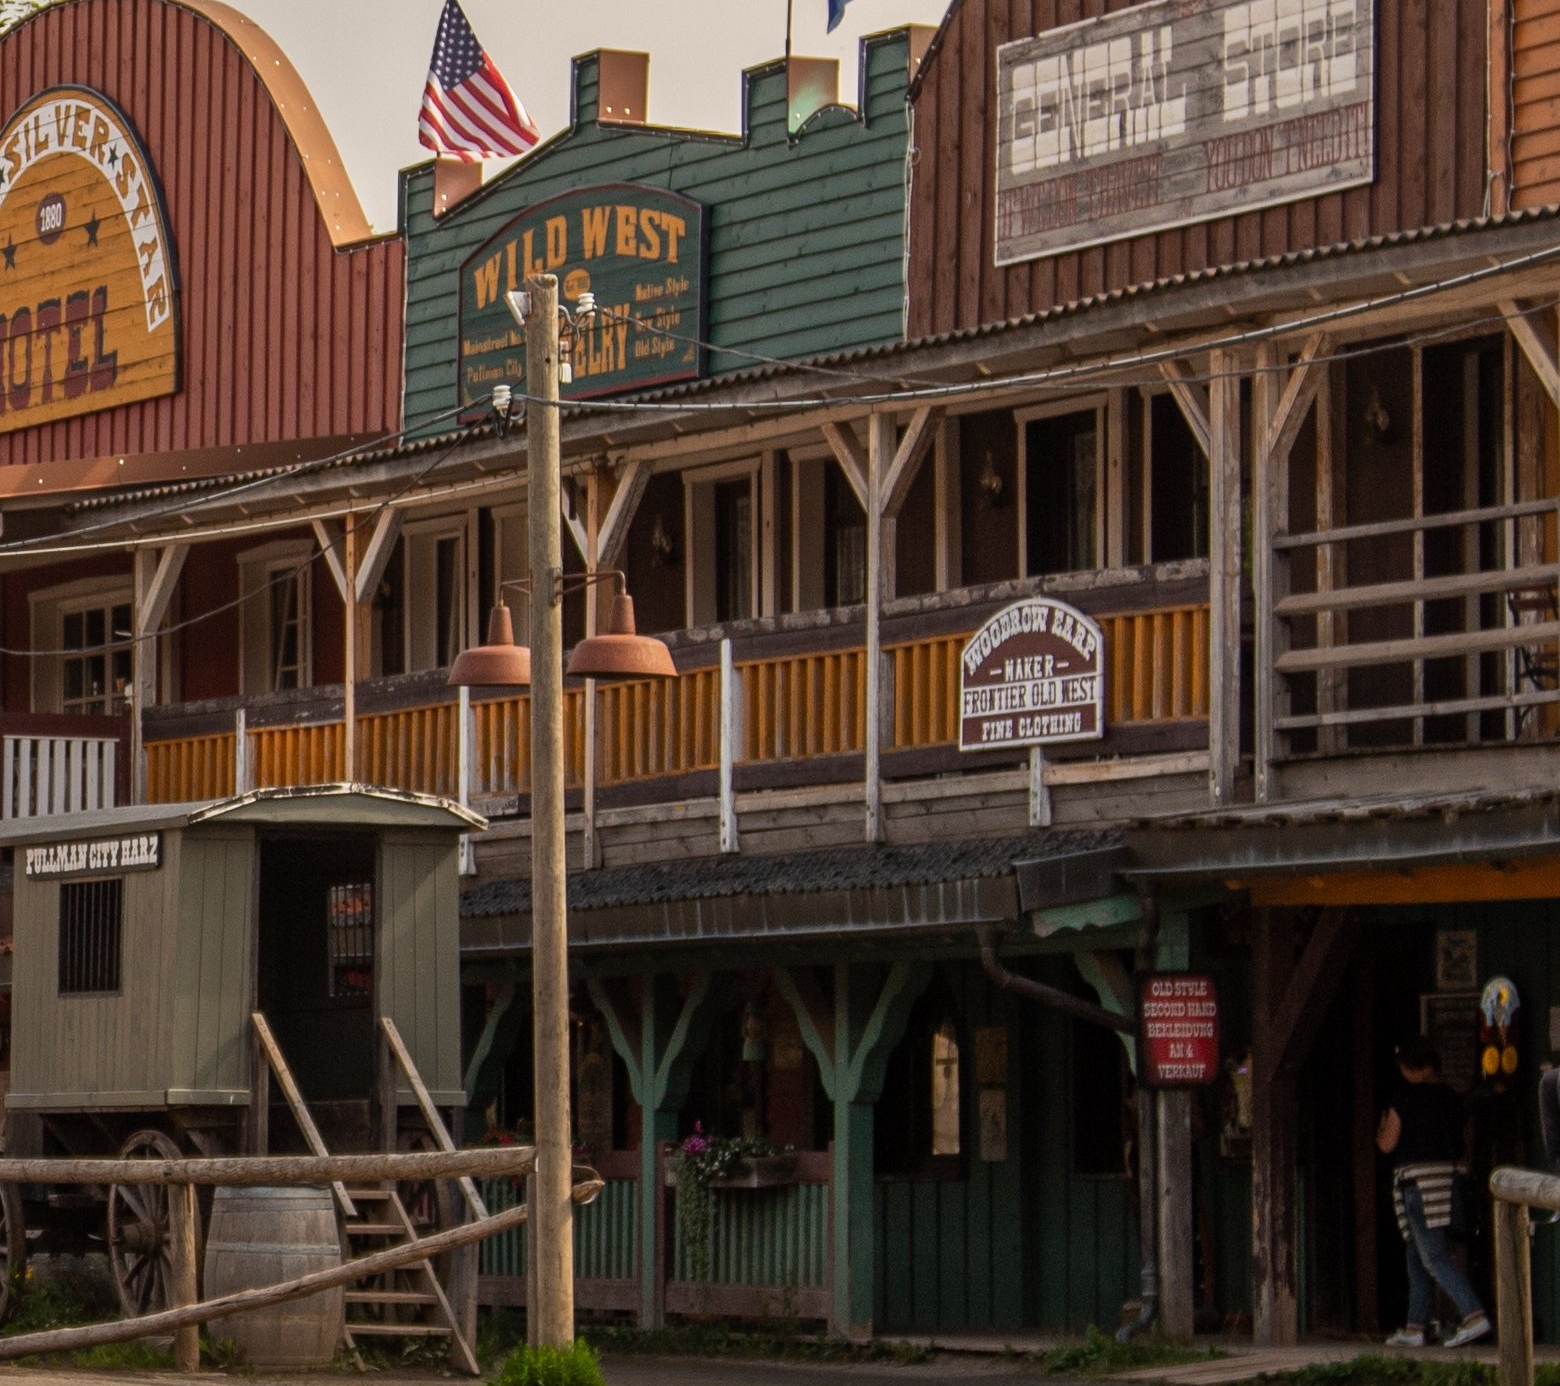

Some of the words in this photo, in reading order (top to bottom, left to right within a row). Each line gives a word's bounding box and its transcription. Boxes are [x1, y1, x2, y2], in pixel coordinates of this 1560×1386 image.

[1011, 25, 1186, 176] GENERAL
[3, 103, 111, 180] SILVER
[115, 155, 171, 326] STAR
[39, 201, 63, 233] 1880
[473, 214, 568, 310] WILD
[582, 205, 686, 264] WEST
[964, 604, 1049, 676] WOODROW
[1051, 608, 1097, 661] EARP
[1005, 654, 1054, 682] MAKER
[963, 685, 1027, 715] FRONTIER
[1031, 680, 1057, 707] OLD
[1061, 676, 1097, 704] WEST
[982, 720, 1013, 742] FINE
[1018, 712, 1081, 737] CLOTHING
[26, 843, 88, 875] PULLMAN
[89, 840, 120, 869] CITY
[120, 835, 158, 866] HARZ
[1152, 981, 1173, 996] OLD
[1174, 981, 1208, 997] STYLE
[1143, 1002, 1186, 1018] SECOND
[1187, 1001, 1217, 1017] HAND
[1148, 1022, 1214, 1039] BEKLEIDUNG
[1157, 1063, 1207, 1080] VERKAUF
